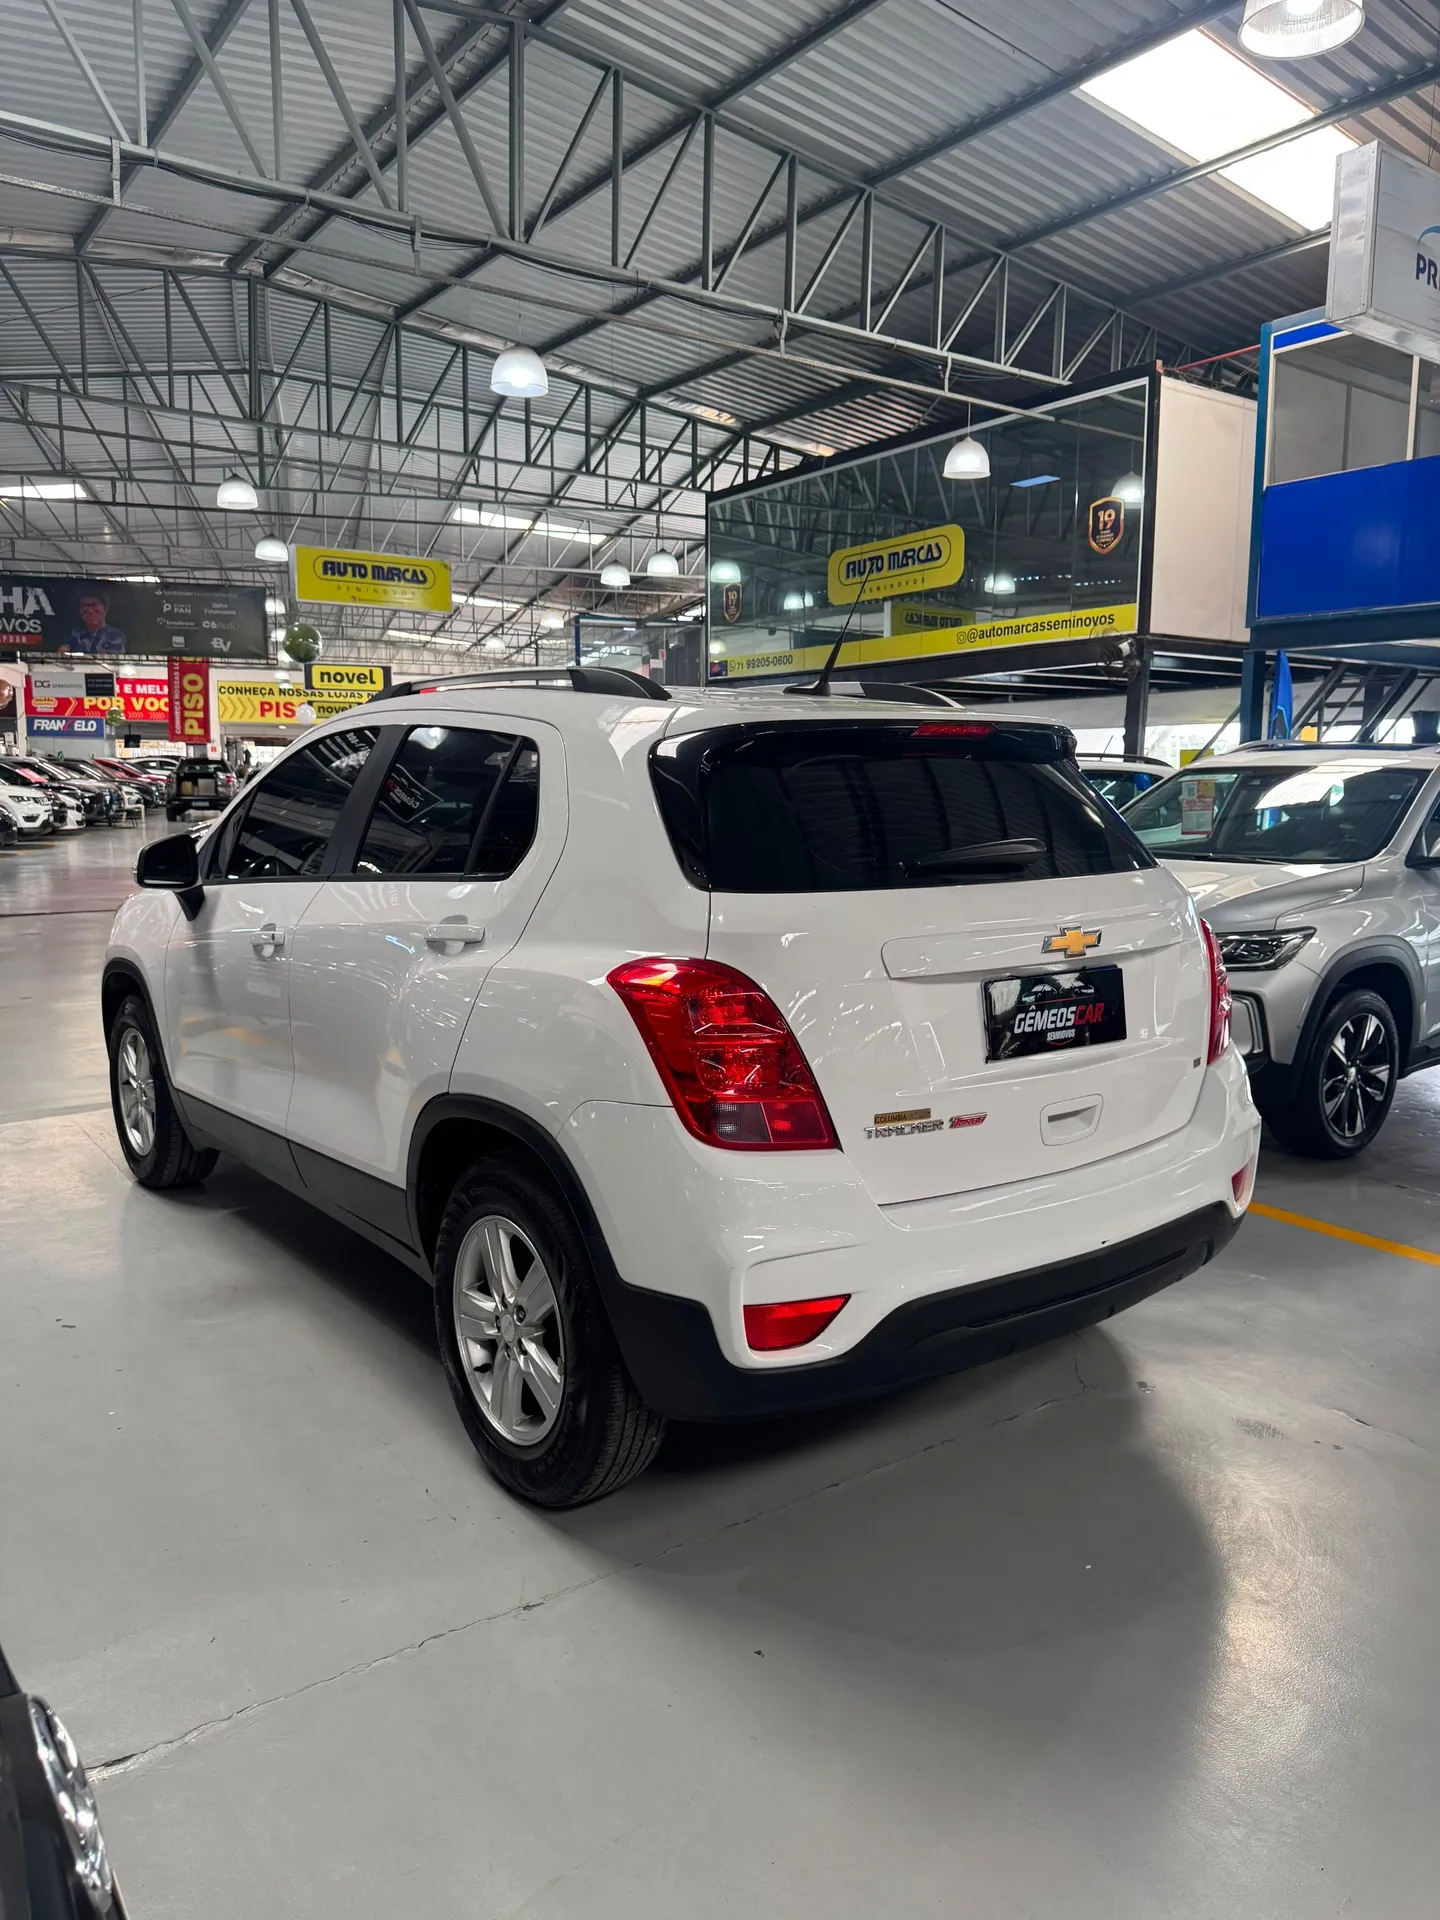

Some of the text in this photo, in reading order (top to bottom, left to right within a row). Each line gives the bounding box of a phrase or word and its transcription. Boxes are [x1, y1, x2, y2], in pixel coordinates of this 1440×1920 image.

[1416, 252, 1440, 290] PR
[1097, 508, 1116, 530] 19
[845, 542, 942, 580] AUTO MARCAS
[322, 560, 428, 585] AUTO MARCAS
[336, 584, 417, 597] SEMINOVOS
[862, 577, 925, 594] SEMINOVOS
[0, 617, 42, 633] VOS
[967, 613, 1115, 643] @automarcasseminovos
[736, 662, 744, 670] 71
[746, 654, 793, 669] 99205-0600
[34, 680, 50, 689] DG
[320, 669, 376, 685] novel
[219, 685, 275, 699] CONHEÇA
[279, 687, 324, 698] NOSSAS
[183, 673, 204, 735] PISO
[260, 701, 305, 719] PIS
[1047, 1029, 1076, 1041] SEMINOVOS
[864, 1118, 945, 1140] TRACKER
